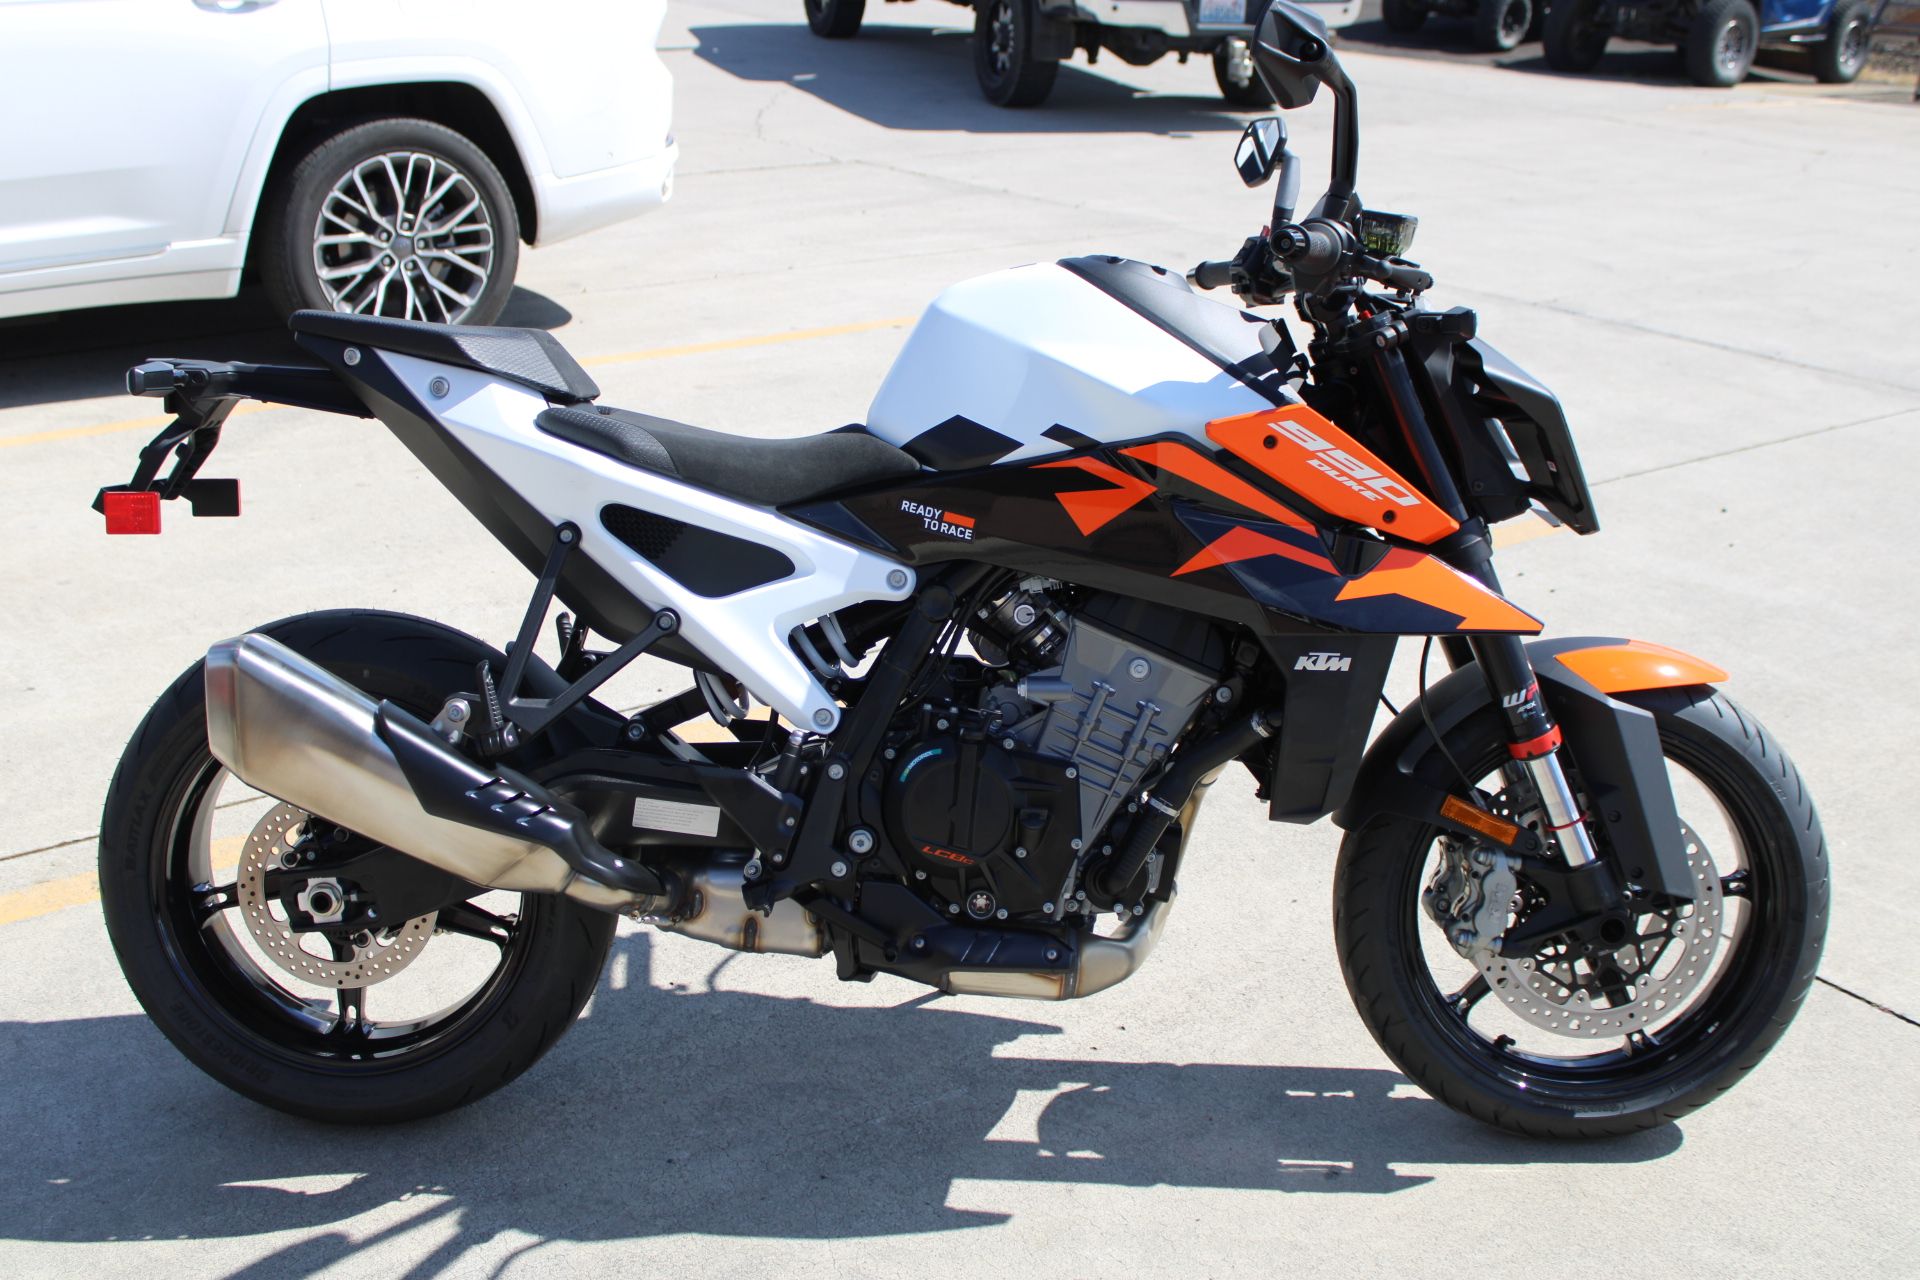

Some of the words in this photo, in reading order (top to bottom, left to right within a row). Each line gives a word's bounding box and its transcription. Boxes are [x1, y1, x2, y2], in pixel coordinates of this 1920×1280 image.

[1267, 420, 1421, 507] 990
[1306, 459, 1383, 501] DUKE
[901, 500, 942, 519] READY
[924, 518, 938, 531] TO
[940, 522, 973, 540] RACE
[1294, 652, 1352, 671] KTM
